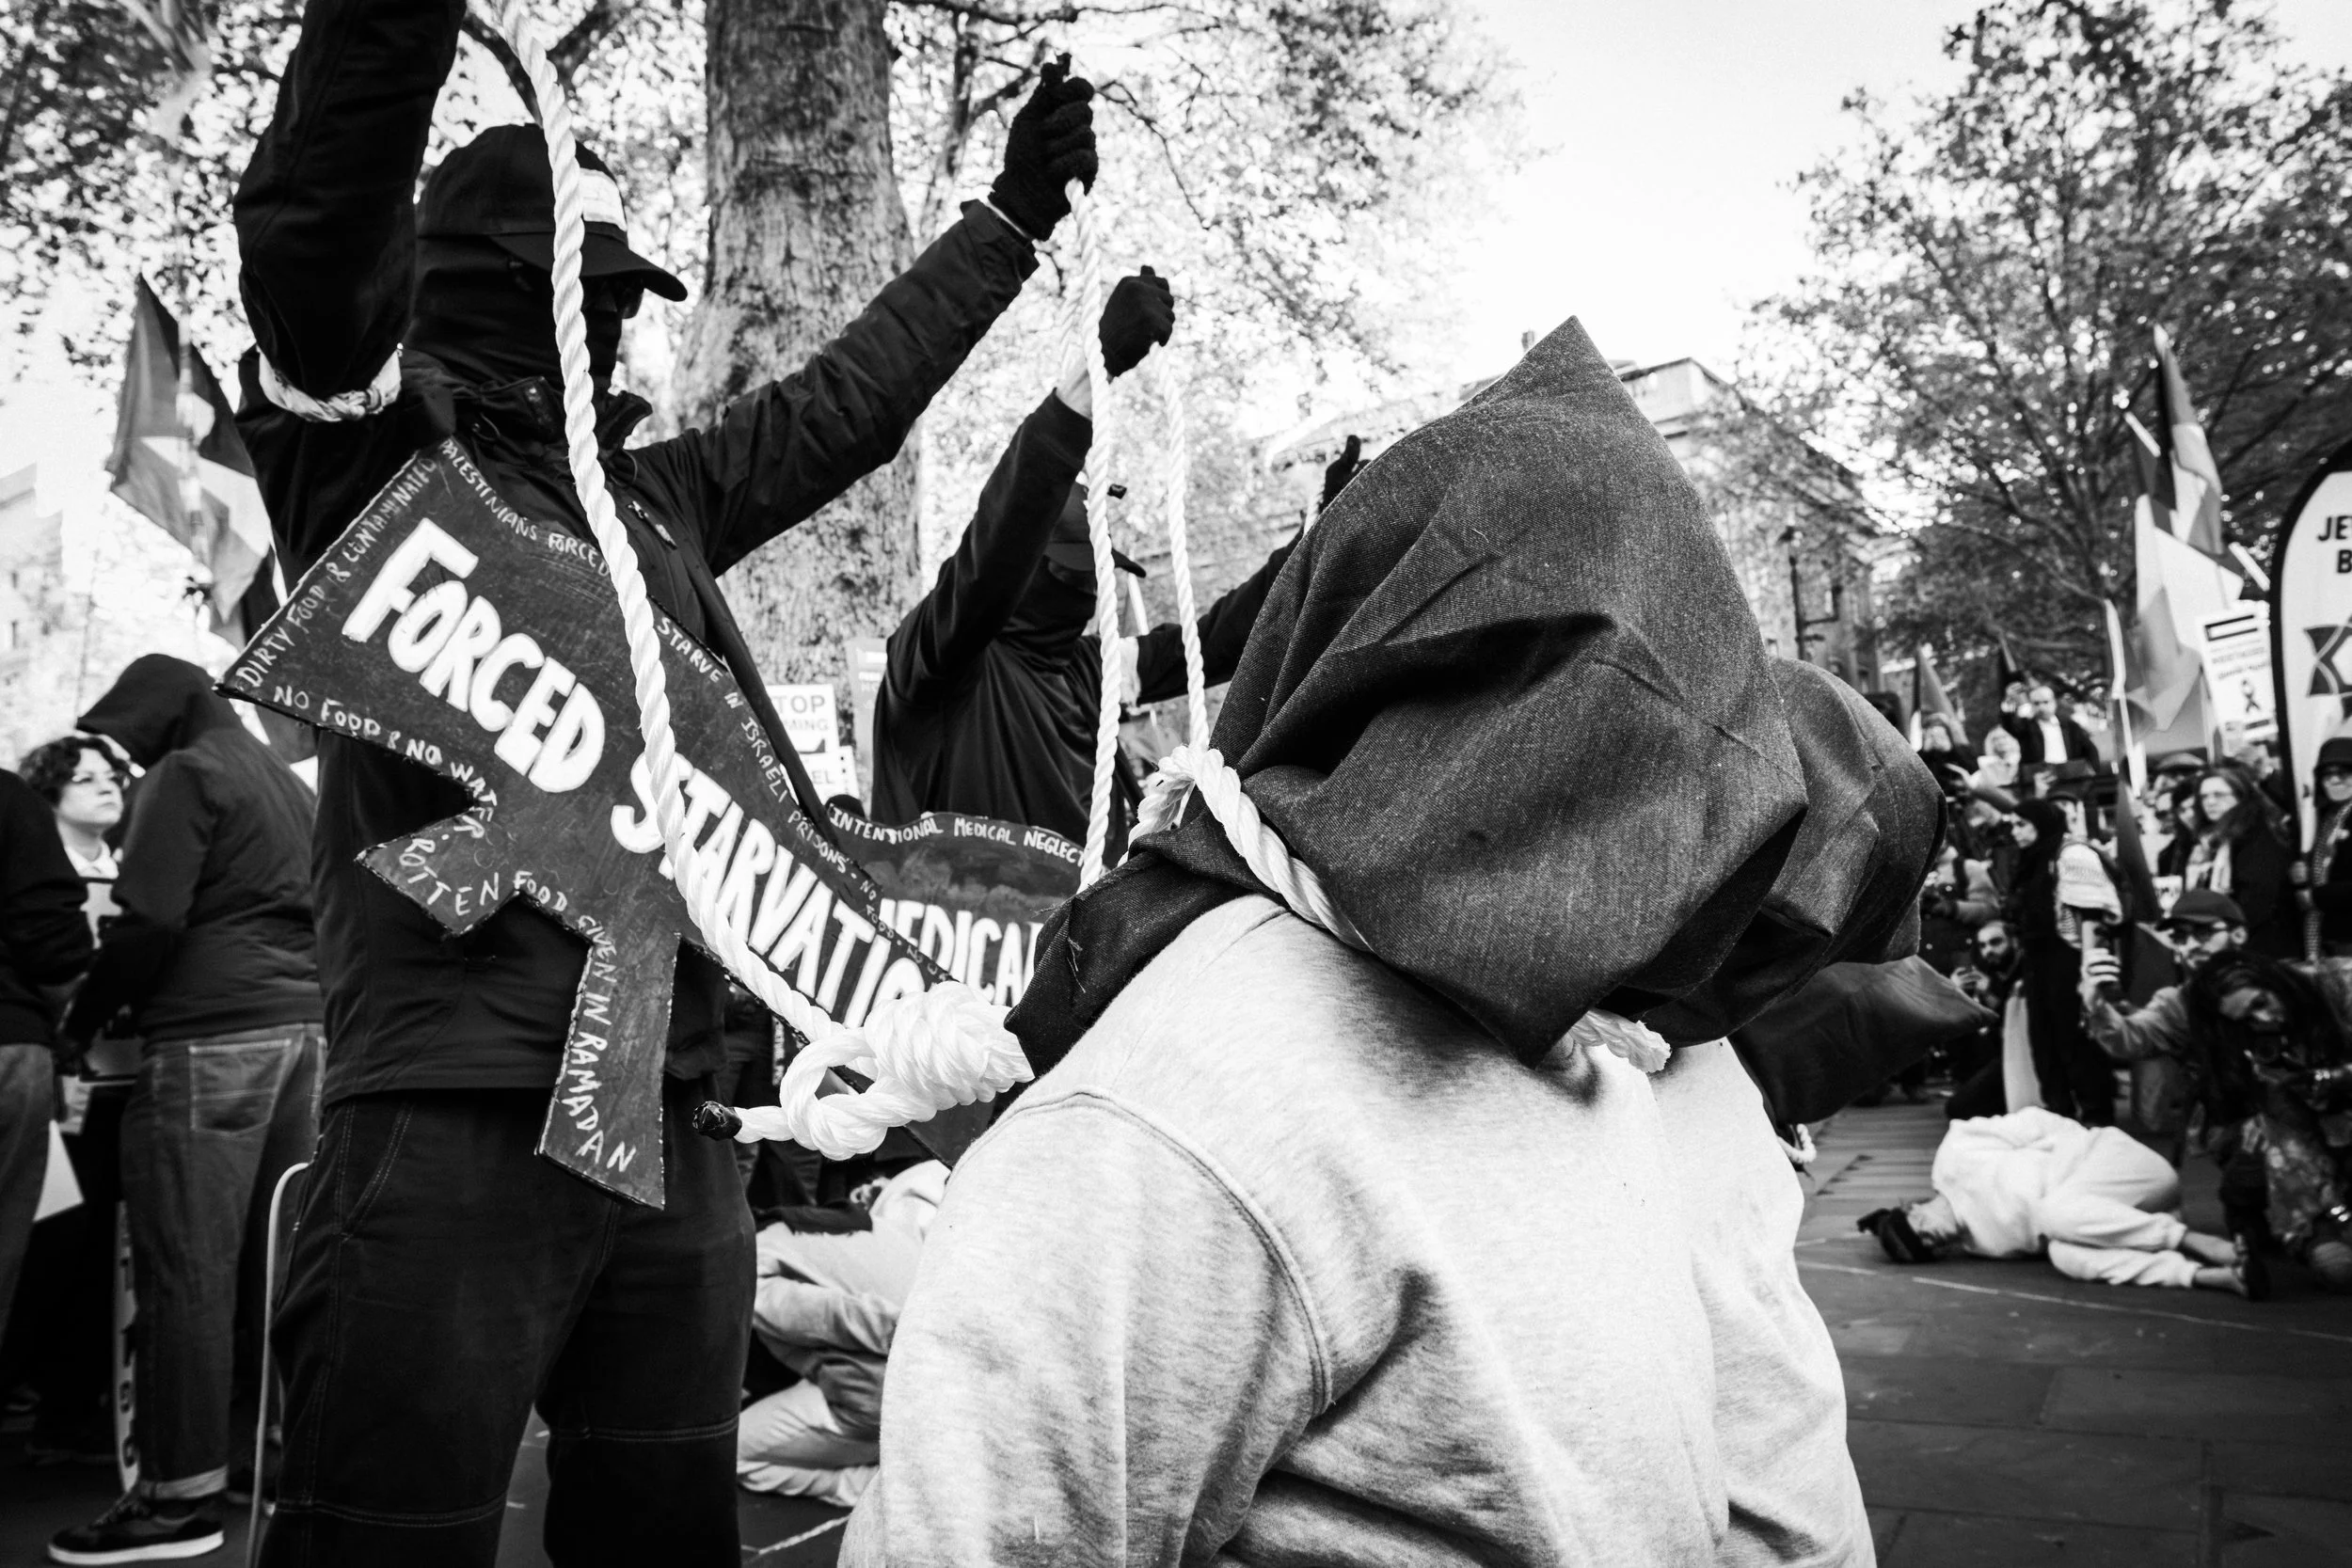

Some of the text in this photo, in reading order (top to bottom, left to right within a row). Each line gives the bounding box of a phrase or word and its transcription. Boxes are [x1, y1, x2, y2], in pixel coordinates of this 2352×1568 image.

[440, 438, 611, 577] PALESTINIANS FORCED
[2317, 515, 2352, 541] JE
[236, 627, 295, 688] DIRTY
[286, 585, 326, 634] FOOD
[342, 518, 605, 793] FORCED
[658, 617, 723, 683] STARVE
[274, 685, 310, 709] NO
[321, 698, 381, 736] FOOD
[406, 738, 443, 765] NO
[724, 691, 743, 709] IN
[771, 694, 826, 715] TOP
[741, 717, 788, 803] ISRAELI
[787, 810, 849, 873] PRISONS
[954, 817, 1016, 846] MEDICAL
[611, 752, 927, 1030] STARVATIO
[860, 879, 877, 900] NO
[866, 904, 894, 939] FOOD
[400, 837, 636, 1173] ROTTEN FOOD GIVEN IN RAMADAN
